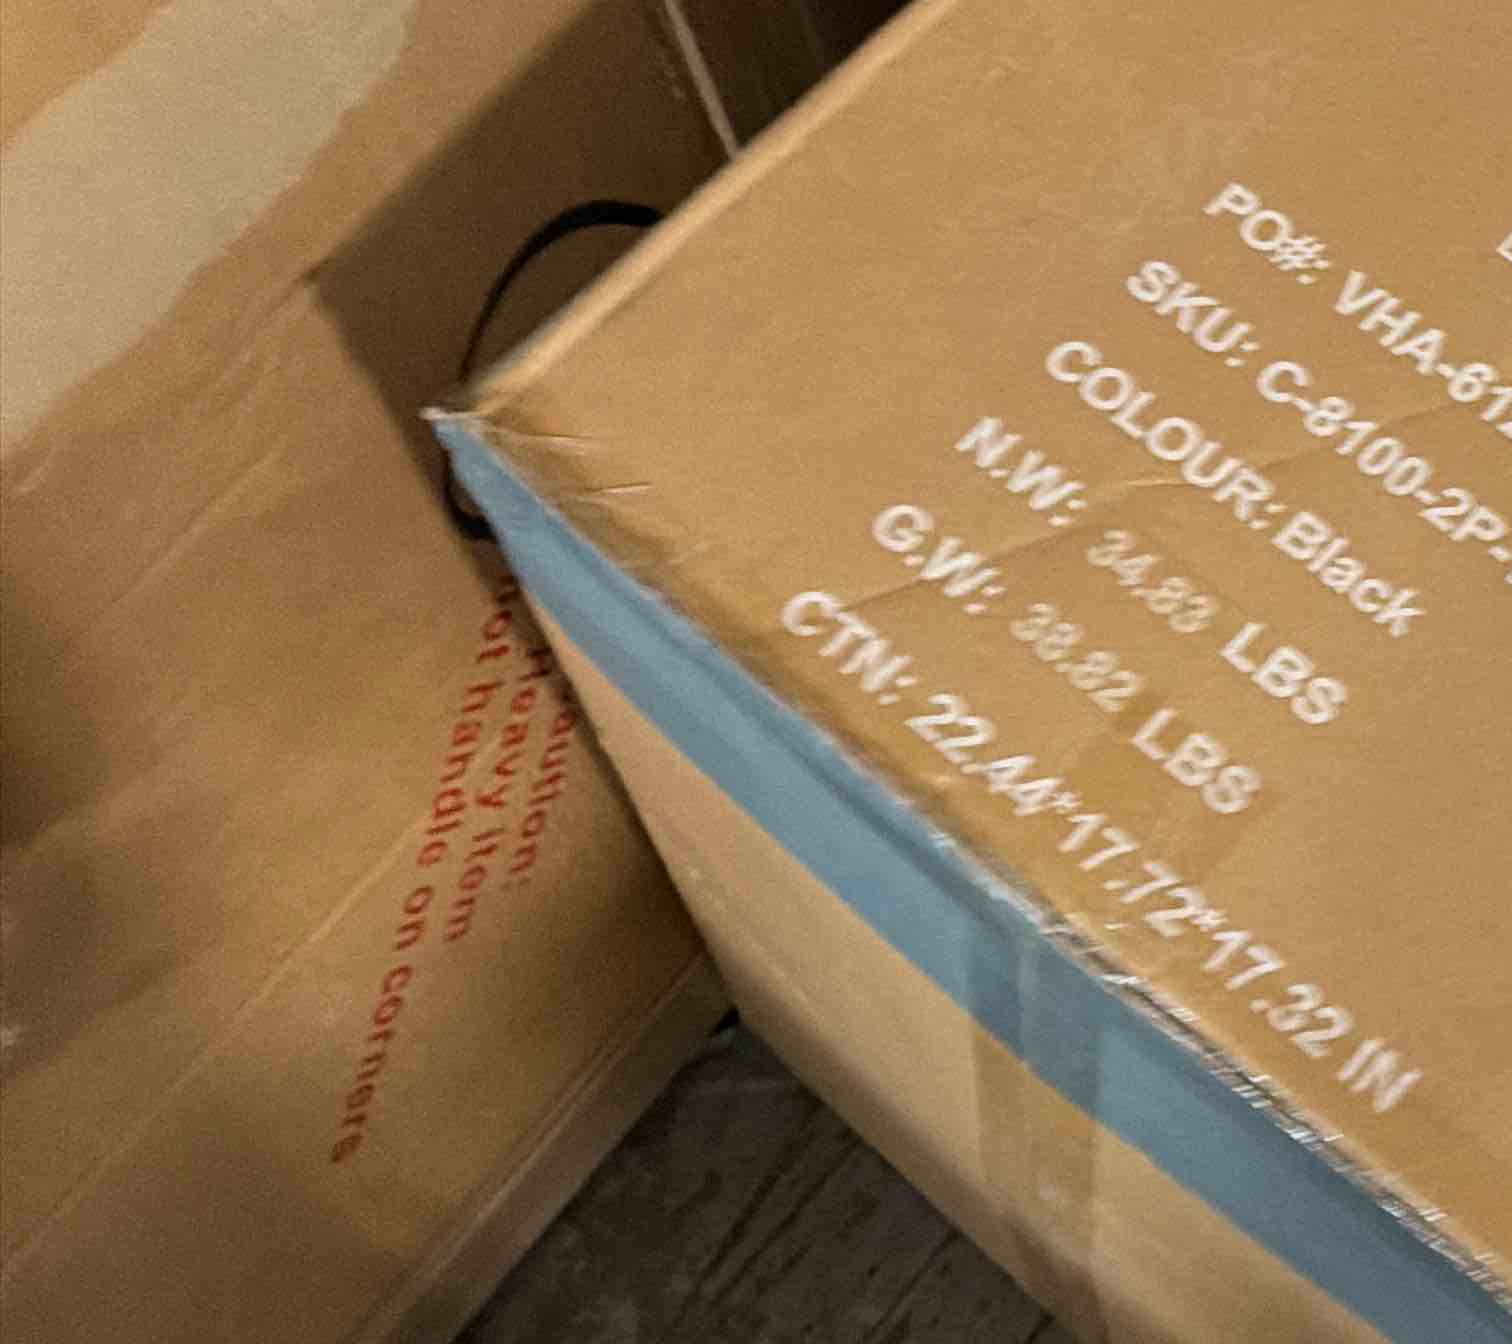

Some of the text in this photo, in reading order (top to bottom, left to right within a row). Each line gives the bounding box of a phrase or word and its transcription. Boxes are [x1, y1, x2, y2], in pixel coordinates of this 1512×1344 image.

[1124, 260, 1261, 367] SKU:
[1202, 182, 1331, 284] PO#:
[954, 416, 1087, 526] N.W:
[1220, 621, 1348, 725] LBS
[1041, 340, 1425, 638] COLOUR: Black
[871, 504, 1005, 615] G.W:
[1132, 707, 1263, 813] LBS
[416, 681, 506, 868] handle
[782, 590, 917, 705] CTN:
[1337, 1038, 1422, 1114] IN
[395, 884, 433, 951] on
[331, 963, 414, 1164] corners
